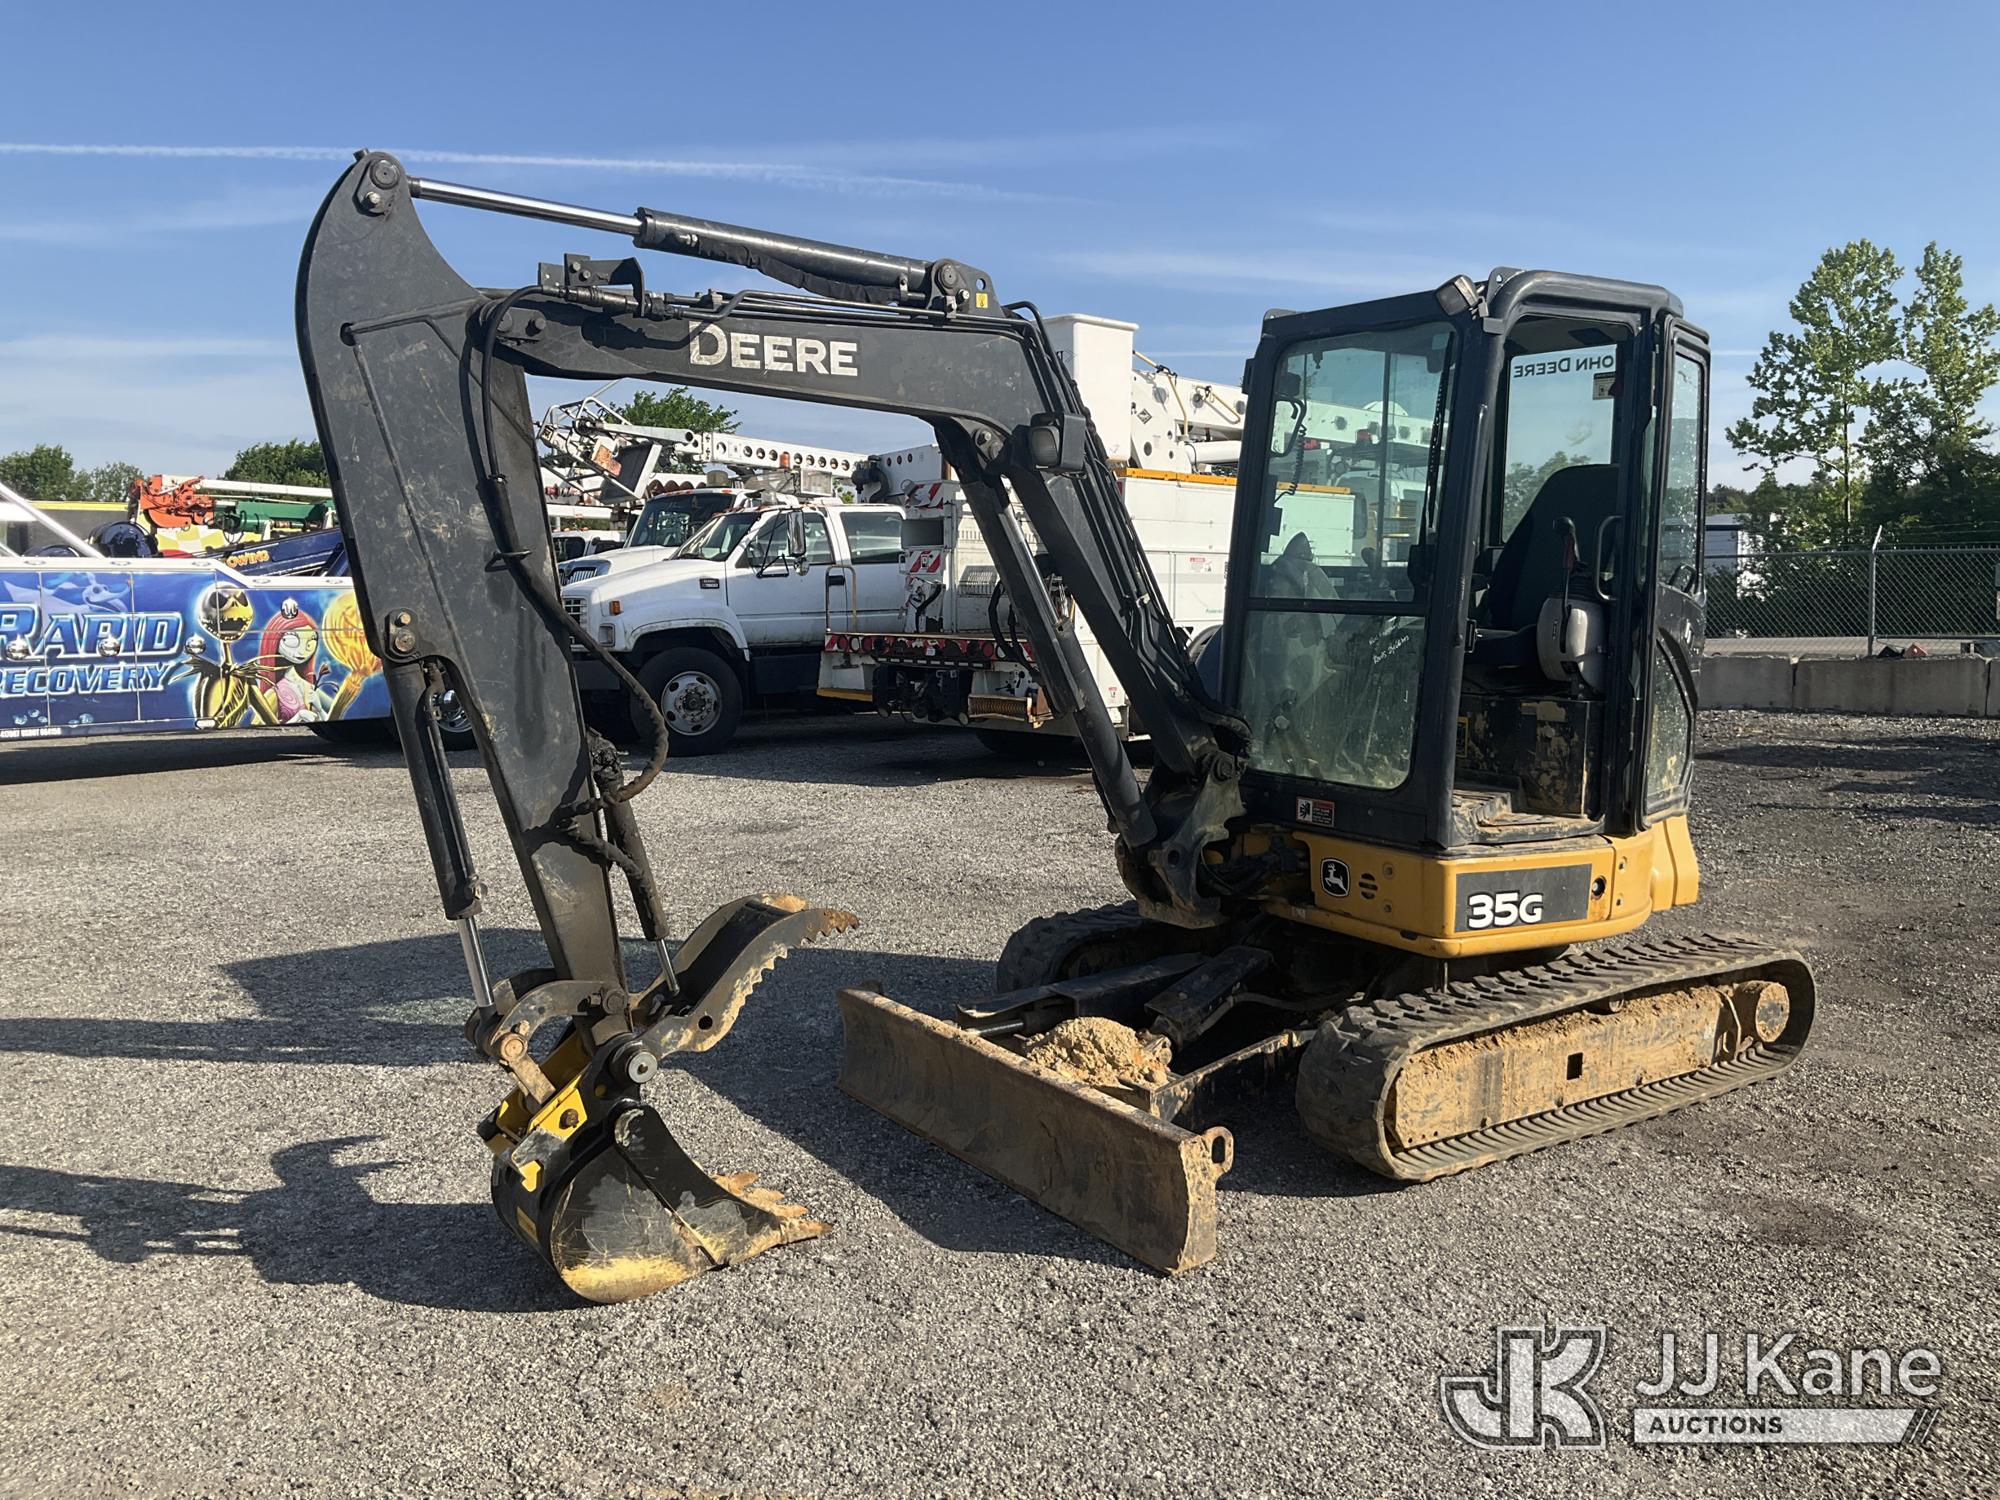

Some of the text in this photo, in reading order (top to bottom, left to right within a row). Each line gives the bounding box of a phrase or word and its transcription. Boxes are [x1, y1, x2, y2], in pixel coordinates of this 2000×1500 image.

[689, 320, 858, 377] DEERE
[226, 550, 270, 569] OWING
[0, 604, 182, 661] RAPID
[1467, 890, 1544, 929] 35G
